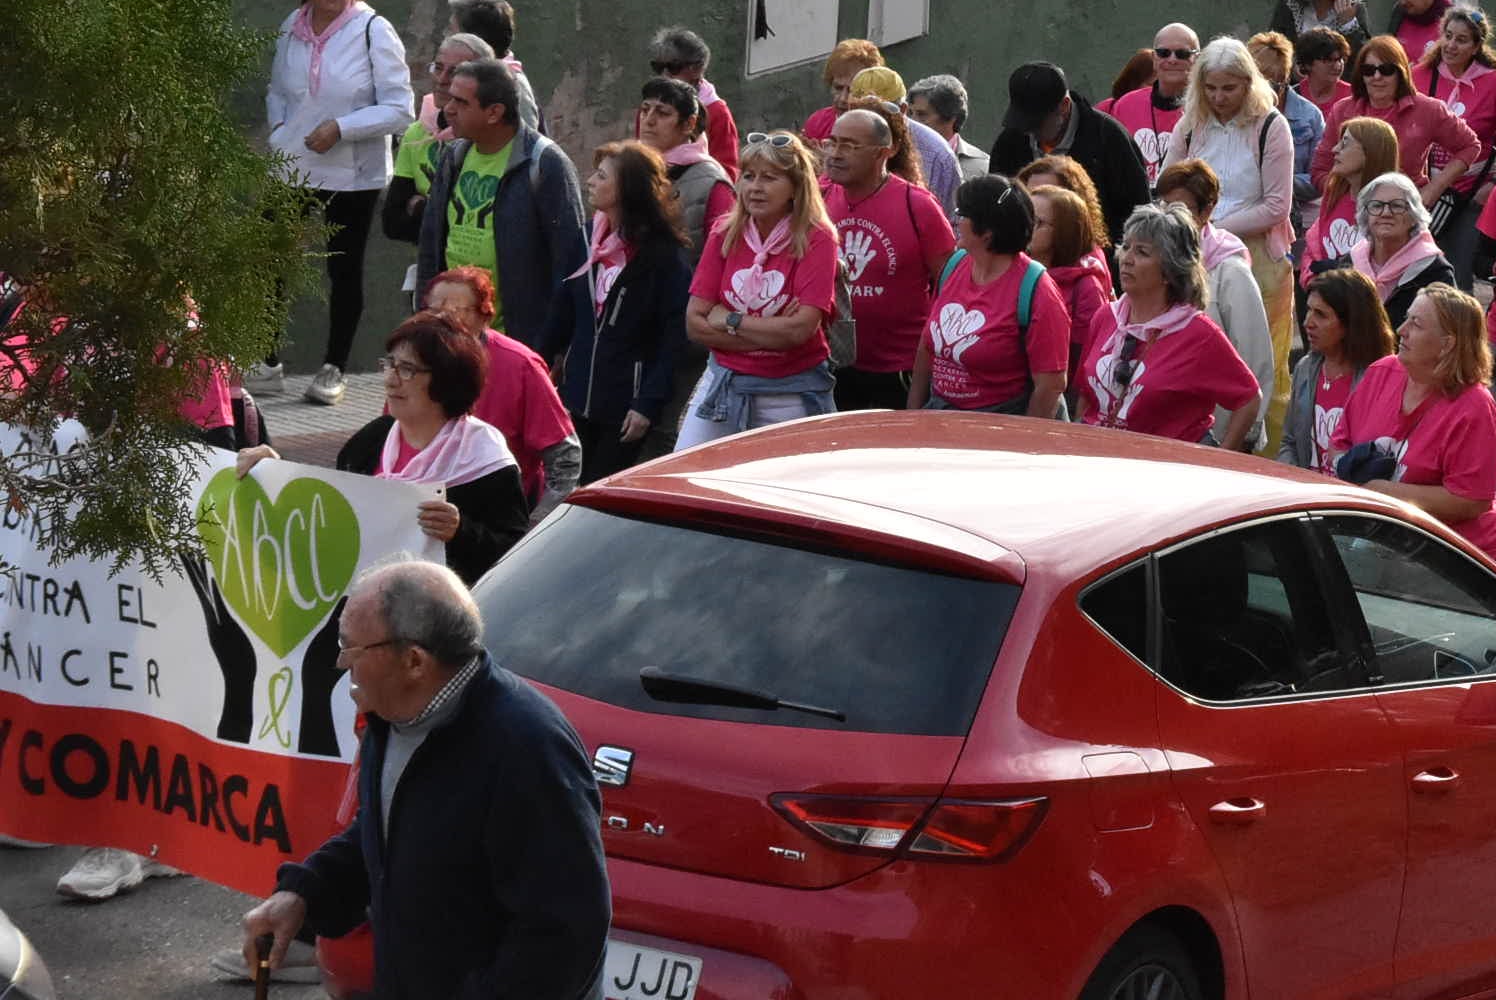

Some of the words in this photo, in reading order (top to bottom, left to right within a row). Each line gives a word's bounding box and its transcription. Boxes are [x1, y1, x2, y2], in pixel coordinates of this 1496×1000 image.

[0, 572, 91, 625] NTRA
[117, 583, 157, 629] EL
[19, 730, 292, 853] COMARCA
[768, 846, 807, 863] TDI
